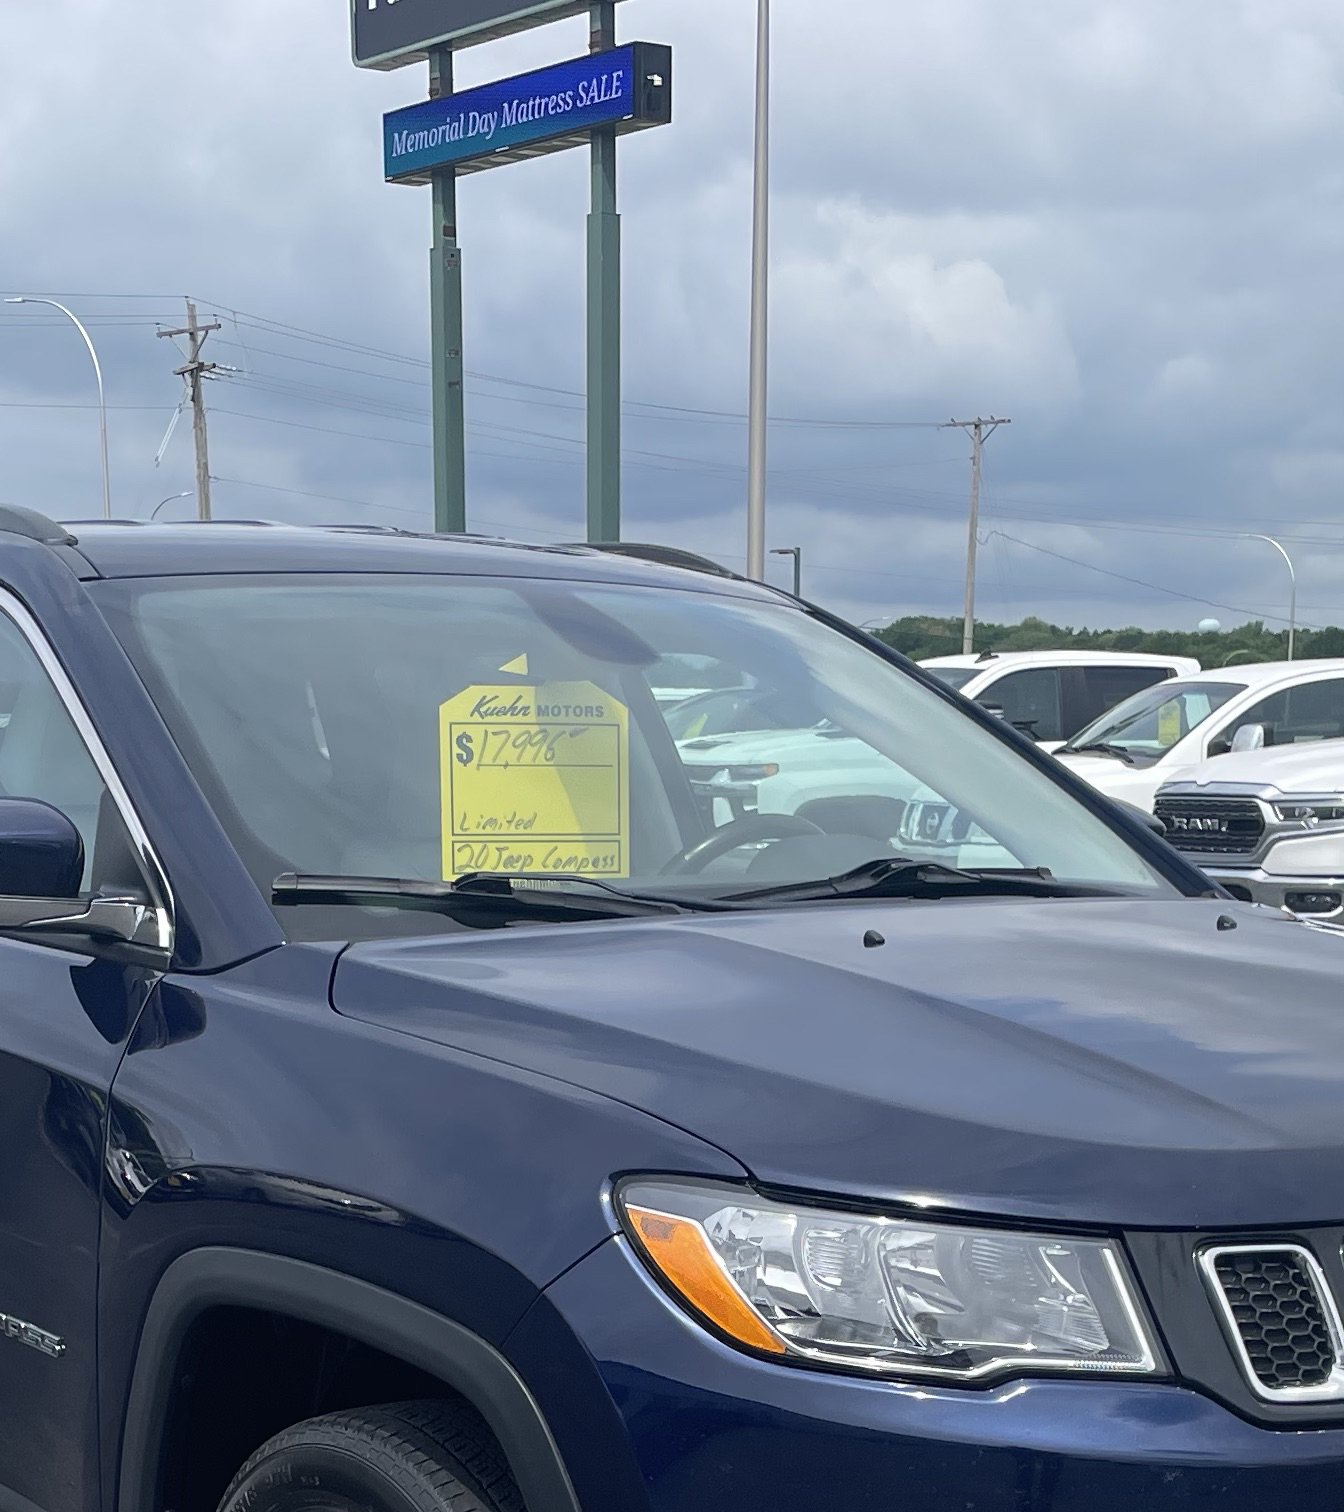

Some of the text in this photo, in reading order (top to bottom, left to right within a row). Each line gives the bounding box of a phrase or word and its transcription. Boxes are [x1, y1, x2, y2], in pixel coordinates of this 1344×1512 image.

[392, 70, 624, 157] Memorial Day Mattress SALE
[470, 695, 604, 719] Kuehn MOTORS
[459, 811, 538, 832] Limited
[1173, 817, 1219, 831] RAM
[456, 843, 615, 872] 20 Jeep Compass
